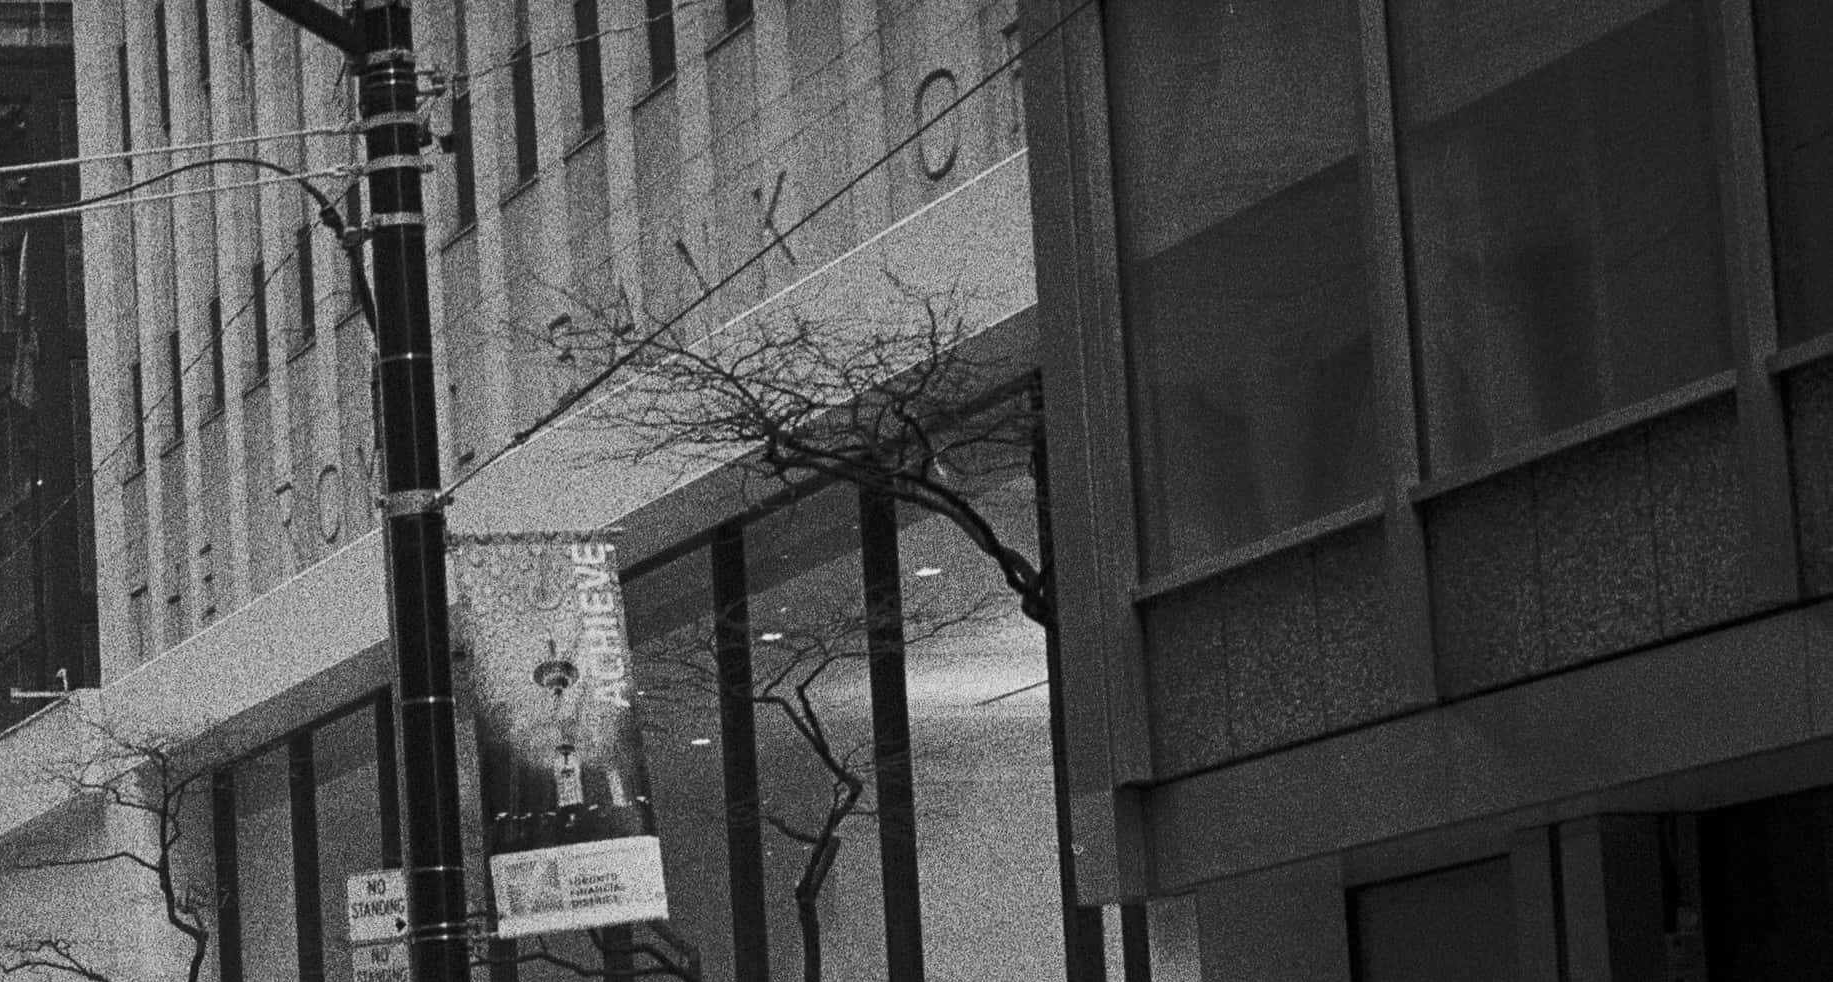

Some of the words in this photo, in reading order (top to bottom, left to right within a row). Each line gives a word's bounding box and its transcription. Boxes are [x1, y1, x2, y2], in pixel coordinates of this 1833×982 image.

[571, 543, 632, 708] ACHIEVE
[366, 879, 386, 896] NO
[351, 897, 406, 919] STANDING
[370, 948, 390, 964] NO
